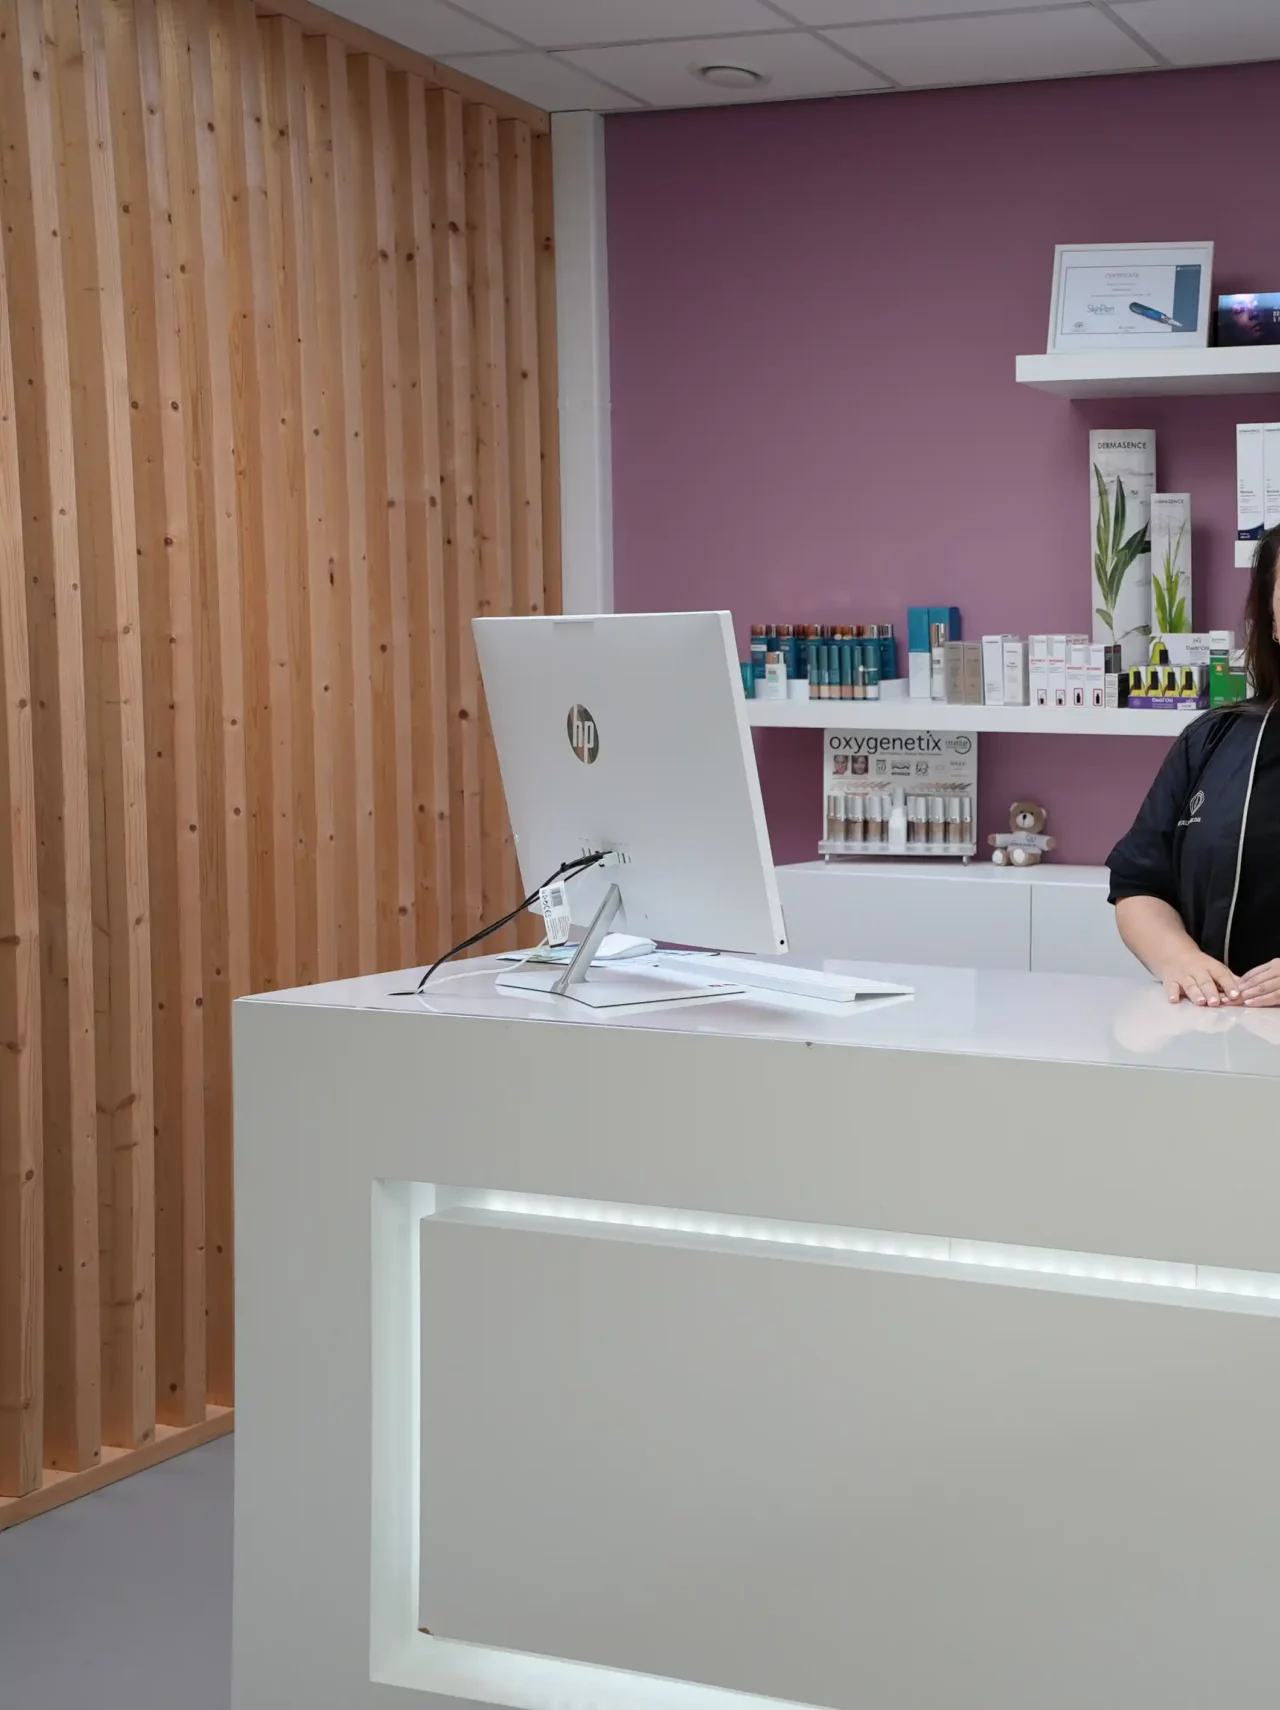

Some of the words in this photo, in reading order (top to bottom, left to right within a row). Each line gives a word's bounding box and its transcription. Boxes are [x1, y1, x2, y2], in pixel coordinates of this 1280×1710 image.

[1097, 441, 1148, 450] DERMASENCE
[573, 704, 595, 763] hp
[829, 730, 942, 754] oxygenetix
